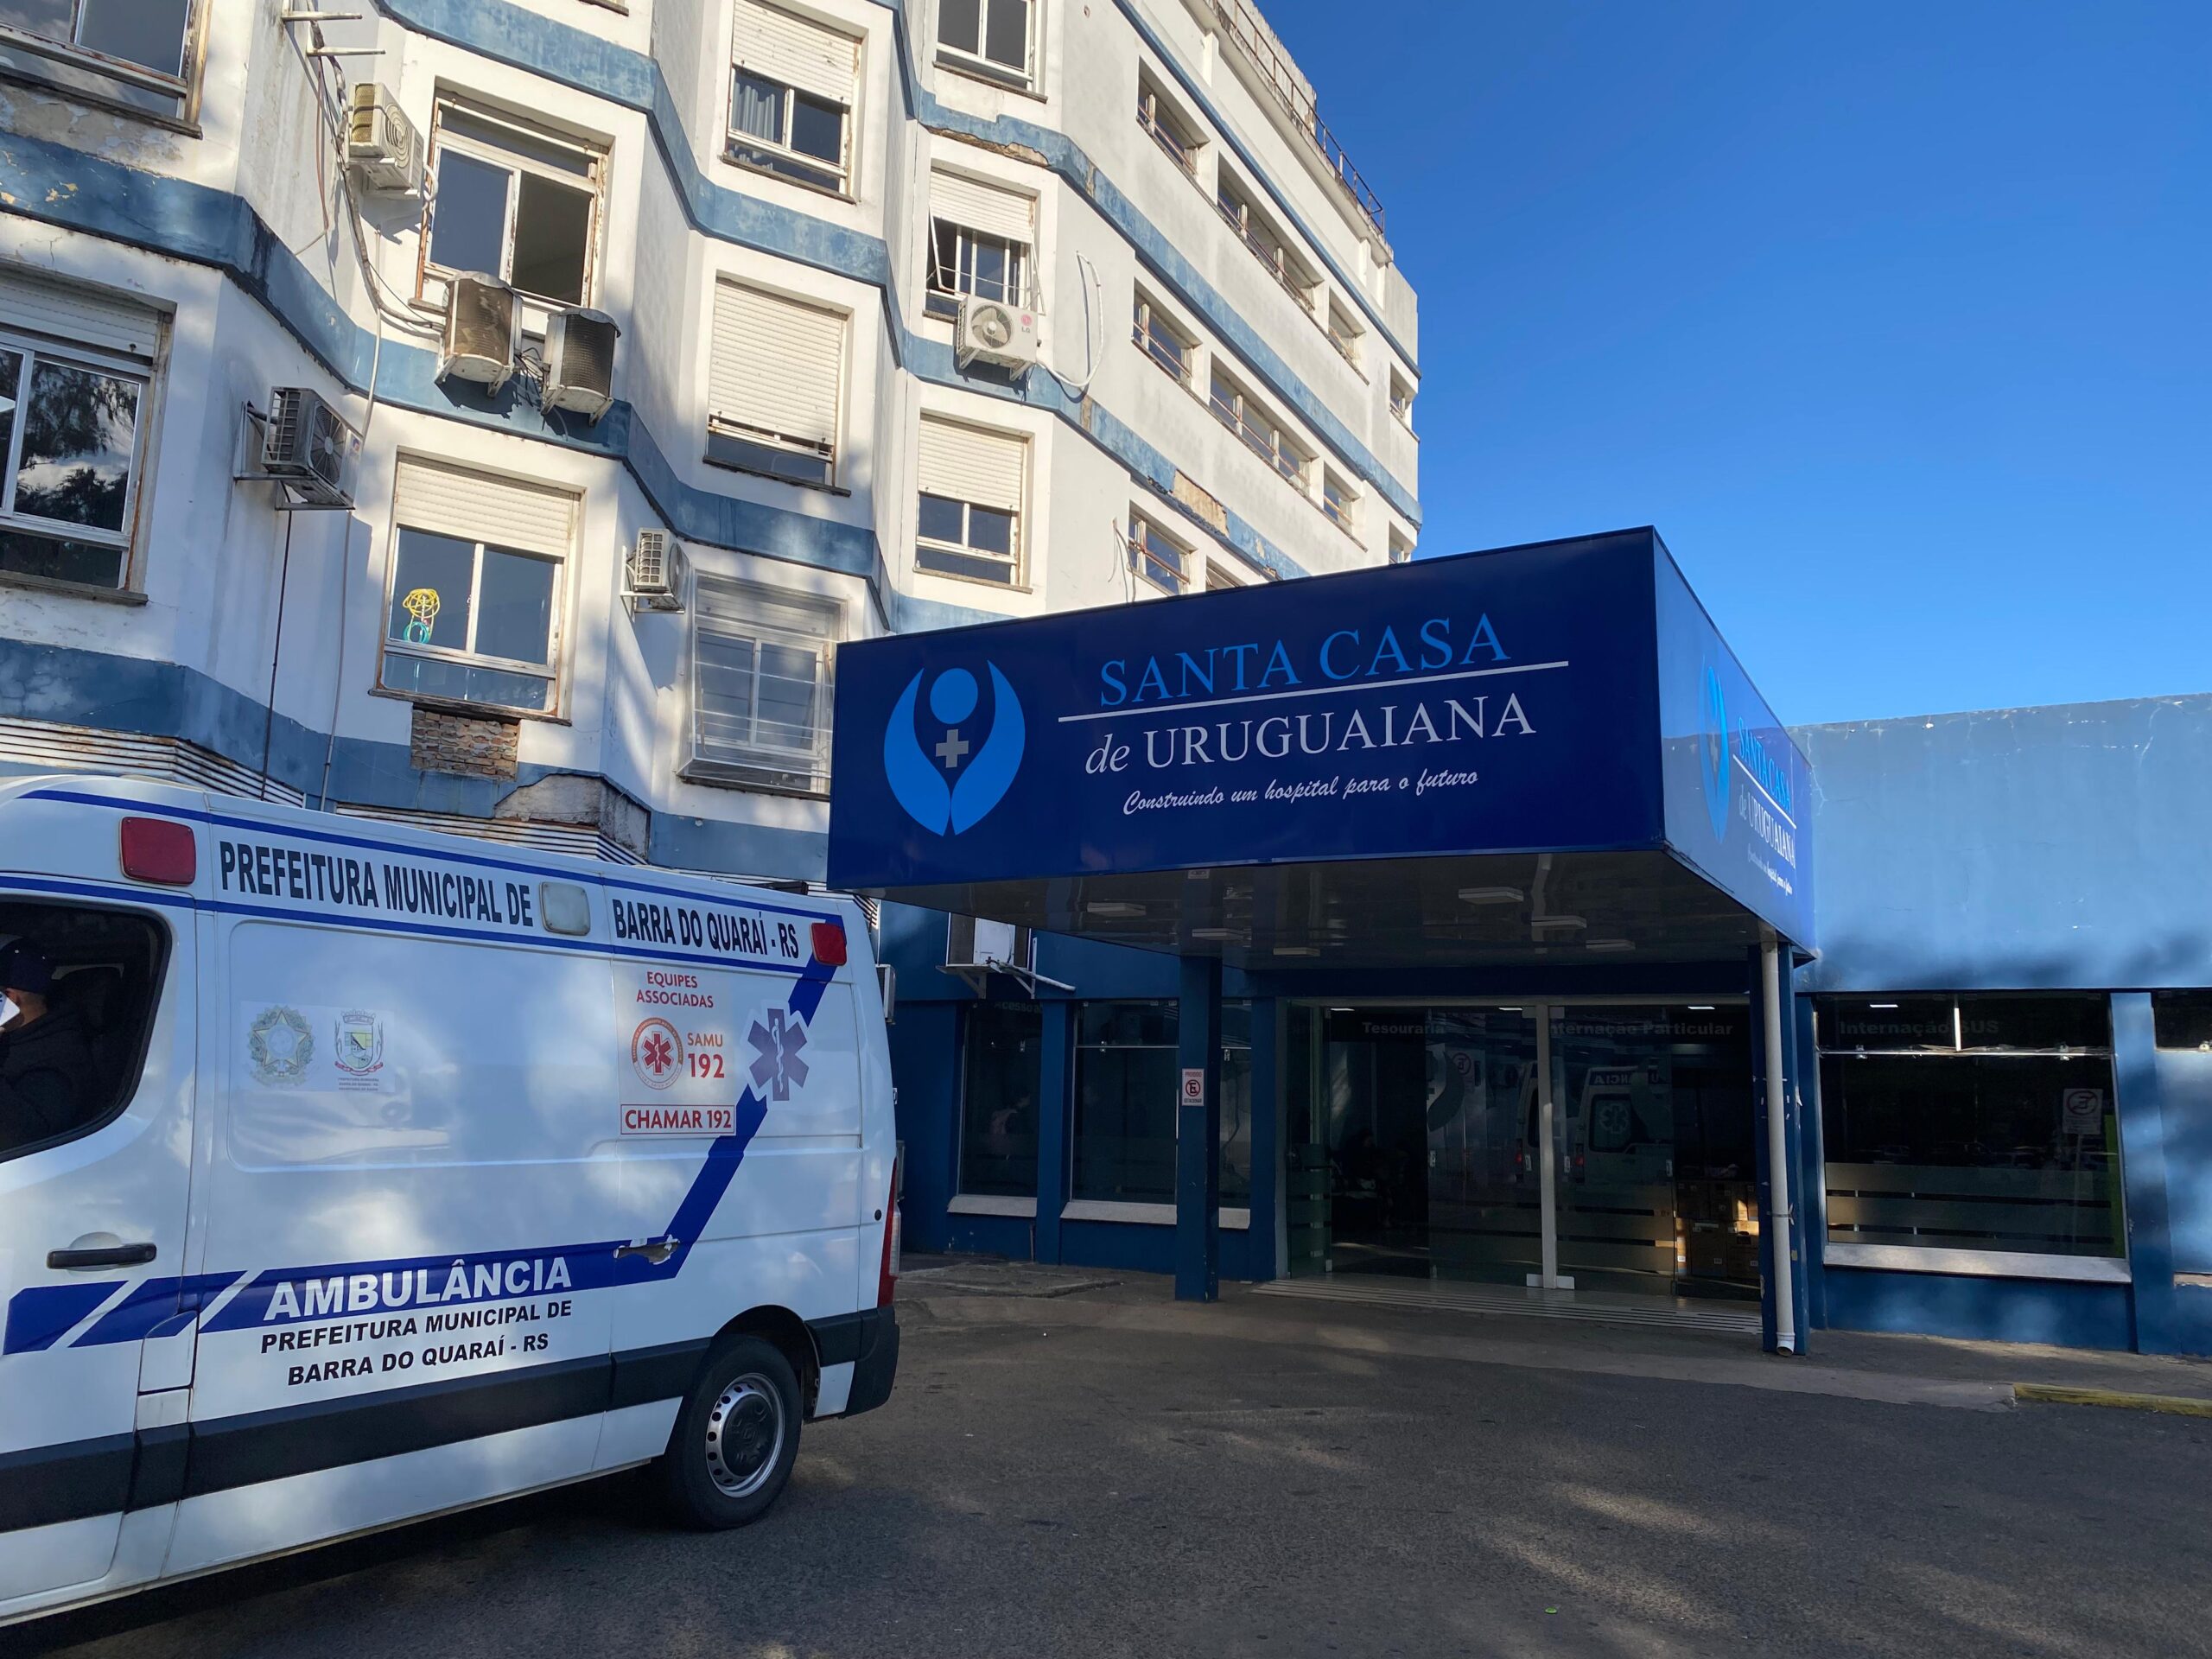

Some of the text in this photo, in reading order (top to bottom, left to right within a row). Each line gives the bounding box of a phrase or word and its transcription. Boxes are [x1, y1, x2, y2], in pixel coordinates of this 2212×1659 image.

[1101, 613, 1511, 707] SANTA CASA
[1085, 693, 1536, 774] de URUGUAIANA
[1738, 717, 1769, 789] SANTA
[1769, 757, 1791, 814] CASA
[1122, 768, 1479, 816] Construindo um hospital para o futuro
[1748, 791, 1796, 870] URUGUAIANA
[219, 840, 379, 908] PREFEITURA
[383, 863, 503, 924] MUNICIPAL
[505, 882, 534, 927] DE
[612, 899, 677, 944] BARRA
[677, 908, 703, 948] DO
[707, 911, 768, 956] QUARAÍ
[778, 922, 799, 959] RS
[636, 989, 714, 1008] ASSOCIADAS
[646, 971, 698, 988] EQUIPES
[687, 1033, 723, 1047] SAMU
[1362, 1022, 1445, 1035] Tesouraria
[1643, 1022, 1734, 1035] Particular
[688, 1052, 725, 1078] 192
[625, 1109, 732, 1129] CHAMAR 192
[263, 1256, 572, 1321] AMBULÂNCIA
[261, 1300, 572, 1354] PREFEITURA MUNICIPAL DE
[288, 1356, 374, 1386] BARRA
[381, 1351, 414, 1372] DO
[422, 1334, 505, 1367] QUARAÍ
[523, 1333, 549, 1352] RS
